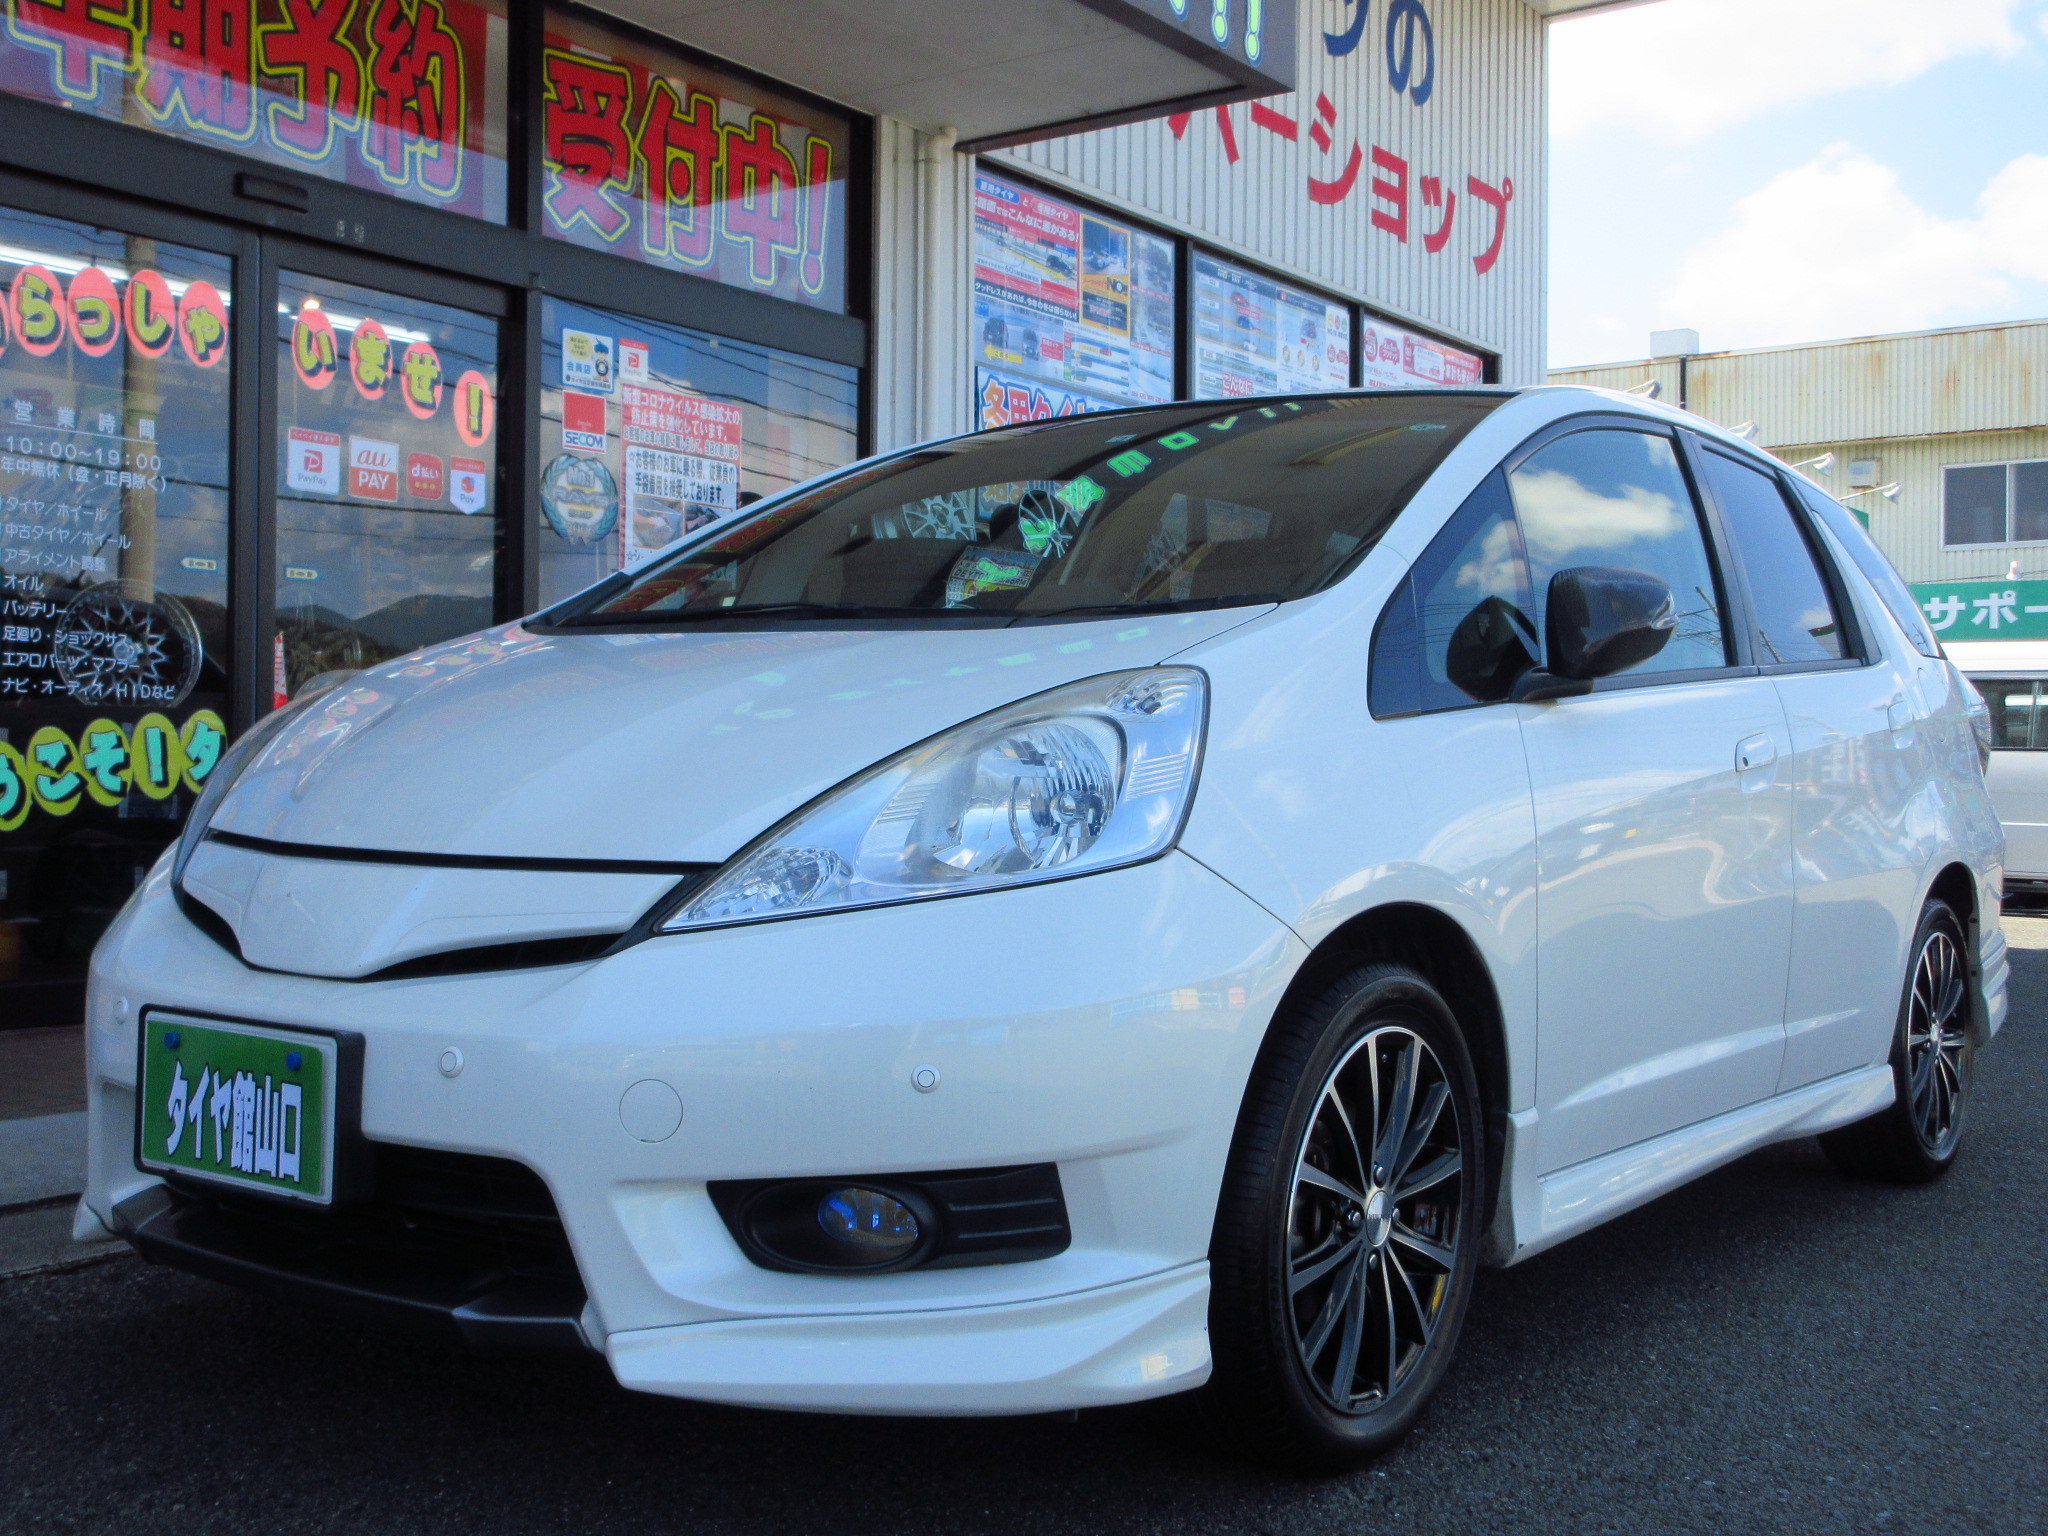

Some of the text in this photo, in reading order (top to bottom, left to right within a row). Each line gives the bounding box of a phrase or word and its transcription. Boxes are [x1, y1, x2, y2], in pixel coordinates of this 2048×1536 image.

[543, 48, 832, 295] 受付中!
[0, 272, 226, 359] らっしゃ
[14, 399, 157, 441] 営業時間
[565, 430, 604, 449] SECOM
[356, 449, 392, 468] au
[297, 473, 328, 488] PayPay
[358, 470, 390, 491] PAY
[411, 462, 440, 481] d払い
[459, 493, 476, 506] Pay
[4, 574, 45, 591] オイル
[3, 601, 69, 619] バッテリー
[166, 1057, 303, 1184] タイヤ館山口
